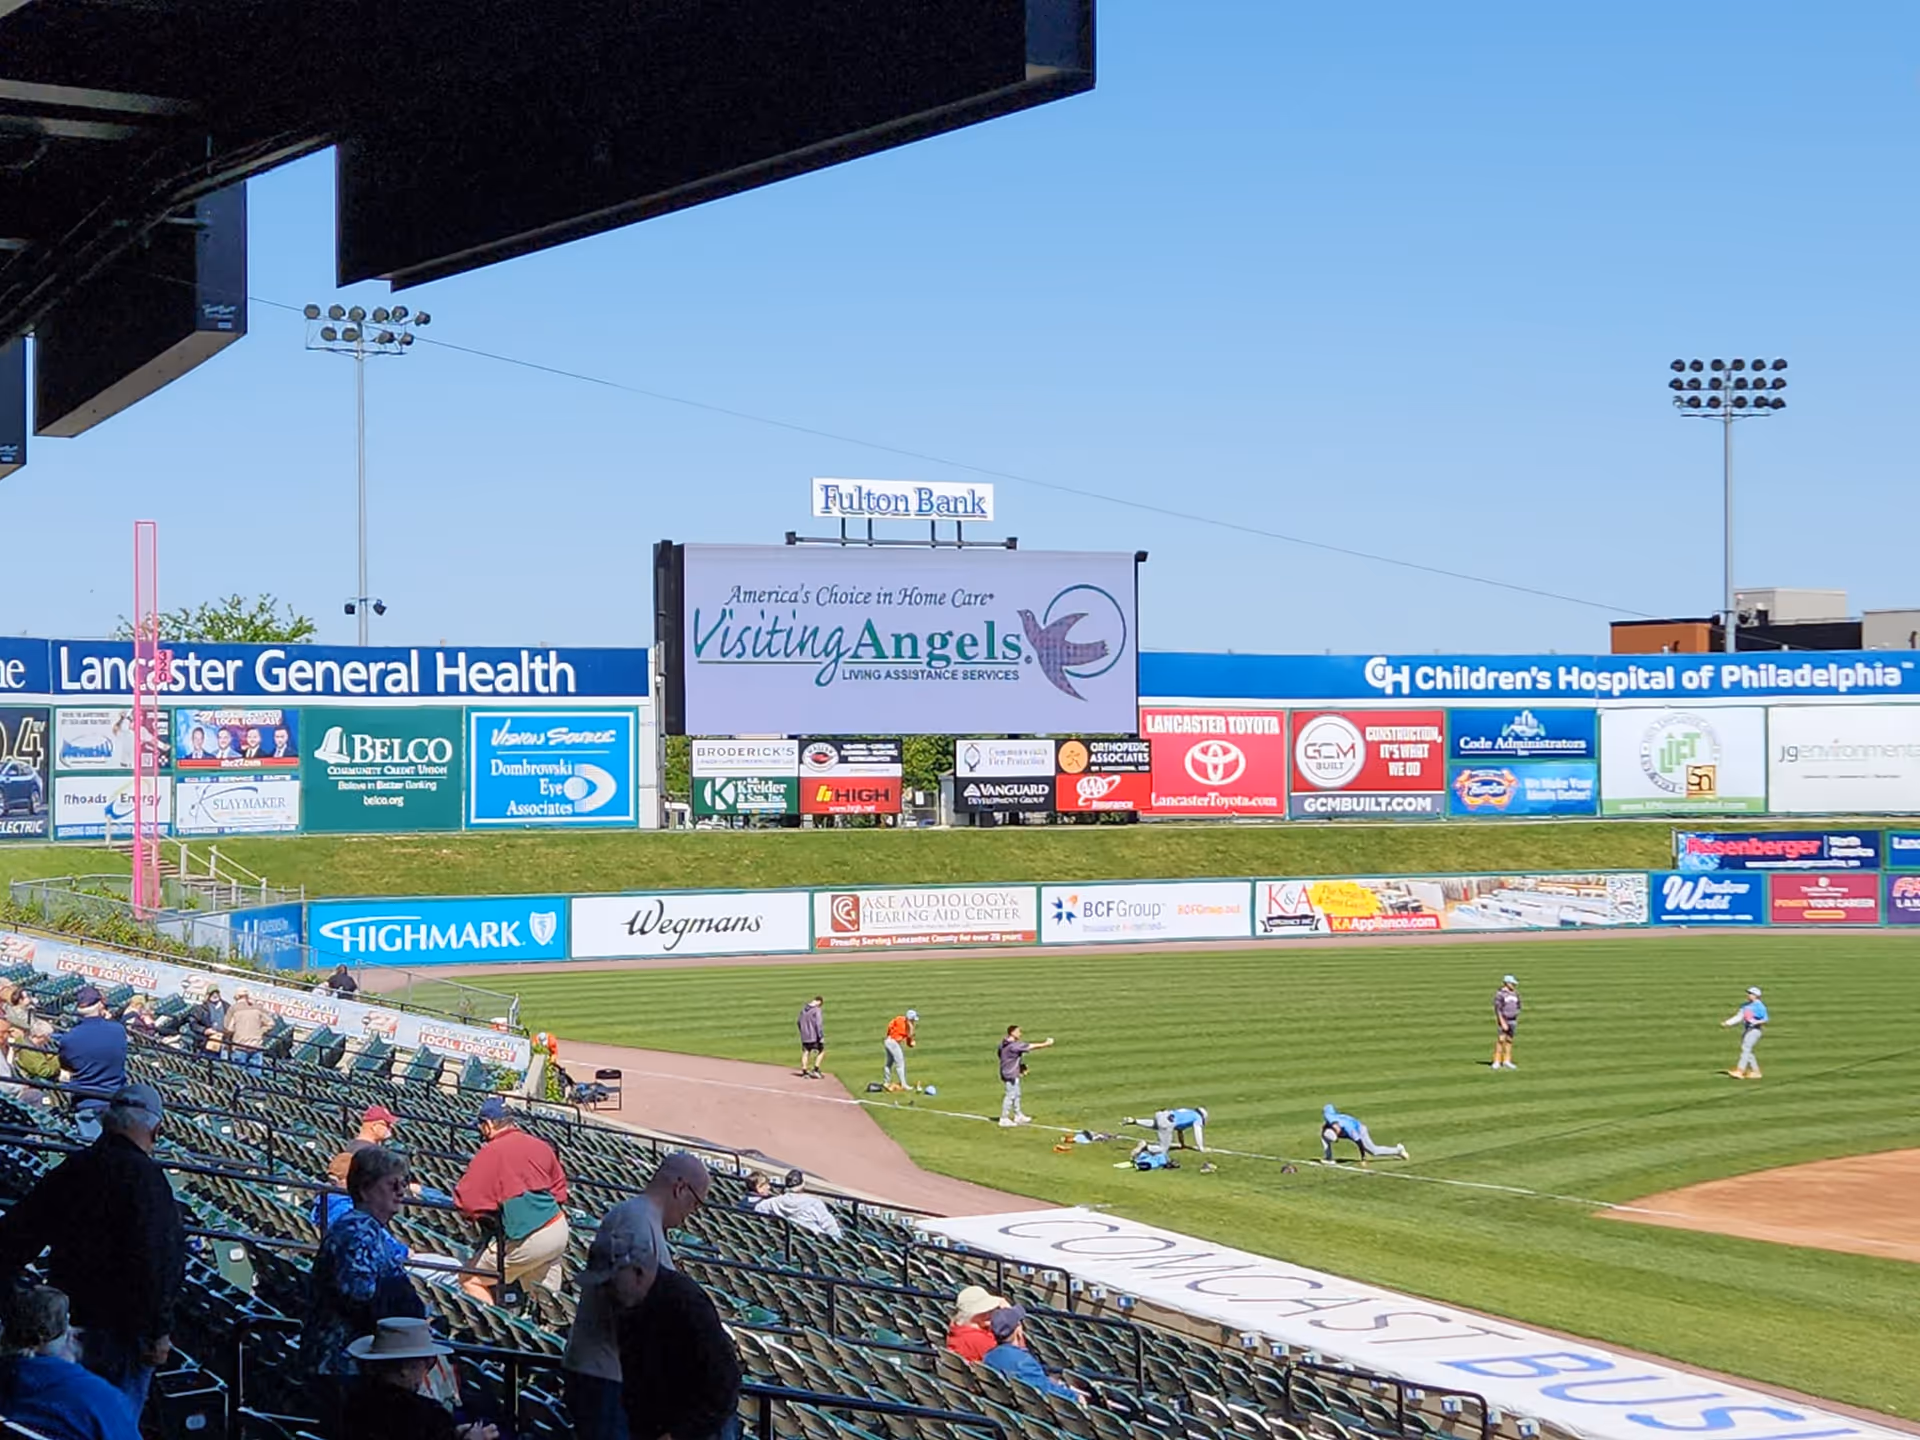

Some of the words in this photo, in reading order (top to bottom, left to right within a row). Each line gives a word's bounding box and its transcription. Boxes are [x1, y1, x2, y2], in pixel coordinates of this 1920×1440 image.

[820, 485, 910, 515] Fulton
[916, 488, 988, 516] Bank
[725, 584, 810, 606] America's
[815, 585, 871, 606] Choice
[876, 587, 893, 606] in
[897, 587, 946, 606] Home
[693, 607, 852, 687] Visiting
[255, 649, 420, 693] General
[435, 648, 577, 693] Health
[842, 669, 881, 681] LIVING
[884, 669, 959, 681] ASSISTANCE
[961, 670, 1020, 682] SERVICES
[1416, 665, 1552, 690] Children's
[1558, 665, 1676, 696] Hospital
[1682, 664, 1716, 688] of
[1146, 714, 1226, 735] LANCASTER
[1228, 715, 1280, 735] TOYOTA
[351, 734, 453, 764] BELCO
[1090, 742, 1150, 752] ORTHOPEDIC
[1459, 736, 1493, 749] Code
[1494, 736, 1587, 749] Administrators
[696, 747, 795, 757] BRODERICK'S
[1090, 753, 1150, 763] ASSOCIATES
[491, 759, 573, 776] Dombrowski
[1315, 761, 1344, 771] BUILT
[539, 778, 563, 796] Eye
[736, 780, 787, 793] Kreider
[835, 788, 890, 802] HIGH
[979, 783, 1049, 796] VANGUARD
[64, 794, 107, 804] Rhoads
[120, 793, 162, 806] Enrgy
[213, 797, 286, 810] SLAYMAKER
[363, 795, 404, 807] belco.org
[507, 800, 573, 816] Associates
[1151, 791, 1277, 809] LancasterToyota.com
[1304, 797, 1432, 812] GCMBUILT.COM
[1686, 837, 1822, 858] Rosenberger
[900, 892, 1008, 909] AUDIOLOGY
[1083, 899, 1162, 919] BCFGroup
[862, 909, 929, 924] HEARING
[933, 908, 960, 921] AID
[965, 907, 1021, 921] CENTER
[620, 898, 764, 952] Wegmans
[1332, 917, 1438, 932] KAAppliance.com
[342, 920, 523, 953] HIGHMARK
[59, 960, 94, 976] LOCAL
[98, 967, 156, 990] FORECAST
[280, 1004, 337, 1026] FORECAST
[421, 1033, 455, 1049] LOCAL
[459, 1041, 514, 1062] FORECAST
[998, 1219, 1526, 1344] COMCAST
